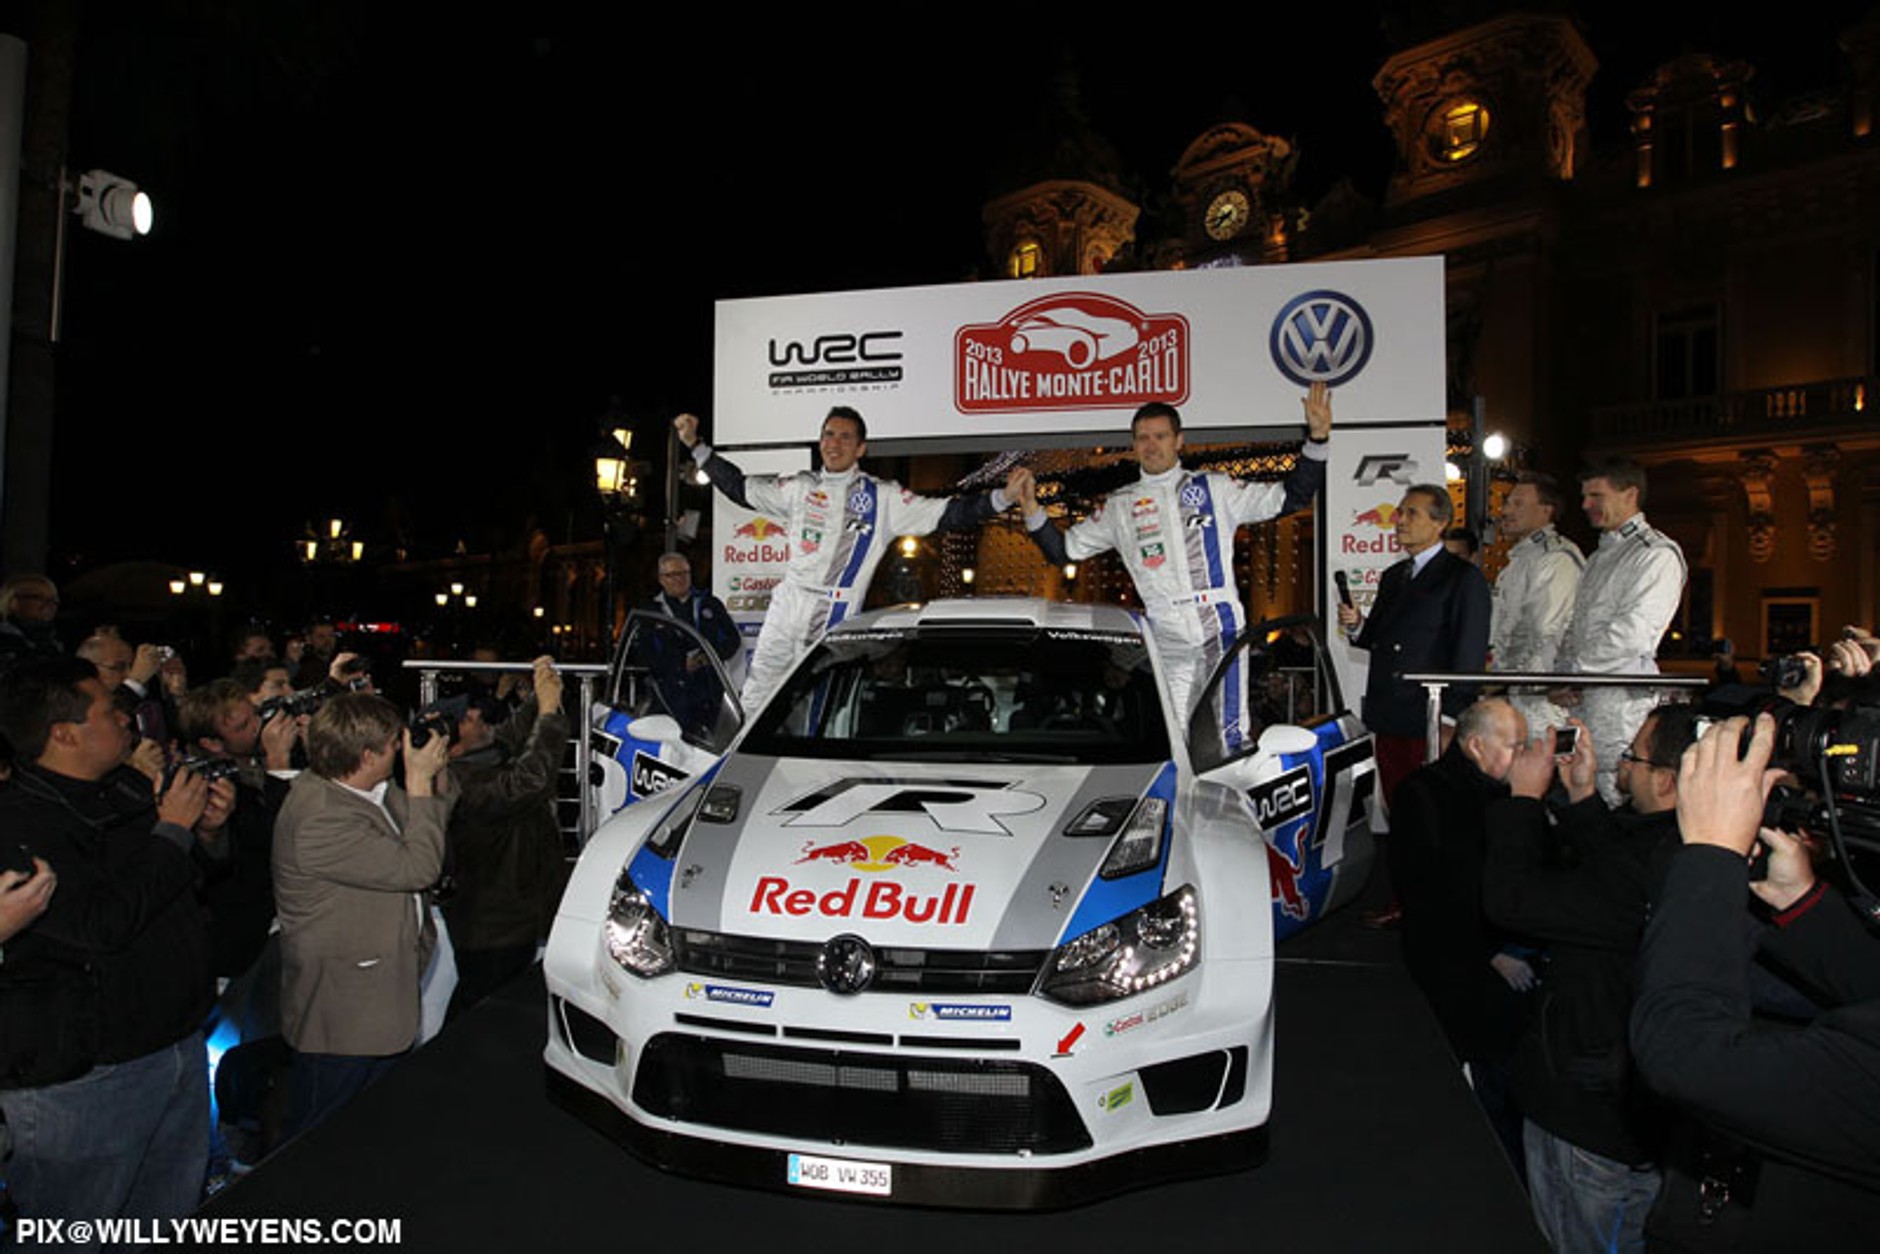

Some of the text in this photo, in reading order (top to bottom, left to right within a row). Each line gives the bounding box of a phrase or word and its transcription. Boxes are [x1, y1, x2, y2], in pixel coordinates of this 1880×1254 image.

[769, 331, 903, 367] WRC
[966, 338, 1002, 365] 2013
[1137, 329, 1178, 361] 2013
[965, 356, 1031, 400] RALLYE
[724, 544, 791, 563] Red Bul
[1342, 533, 1383, 553] Red
[750, 876, 976, 924] Red Bull
[939, 1005, 1010, 1018] MICHELIN
[860, 1169, 888, 1187] 355
